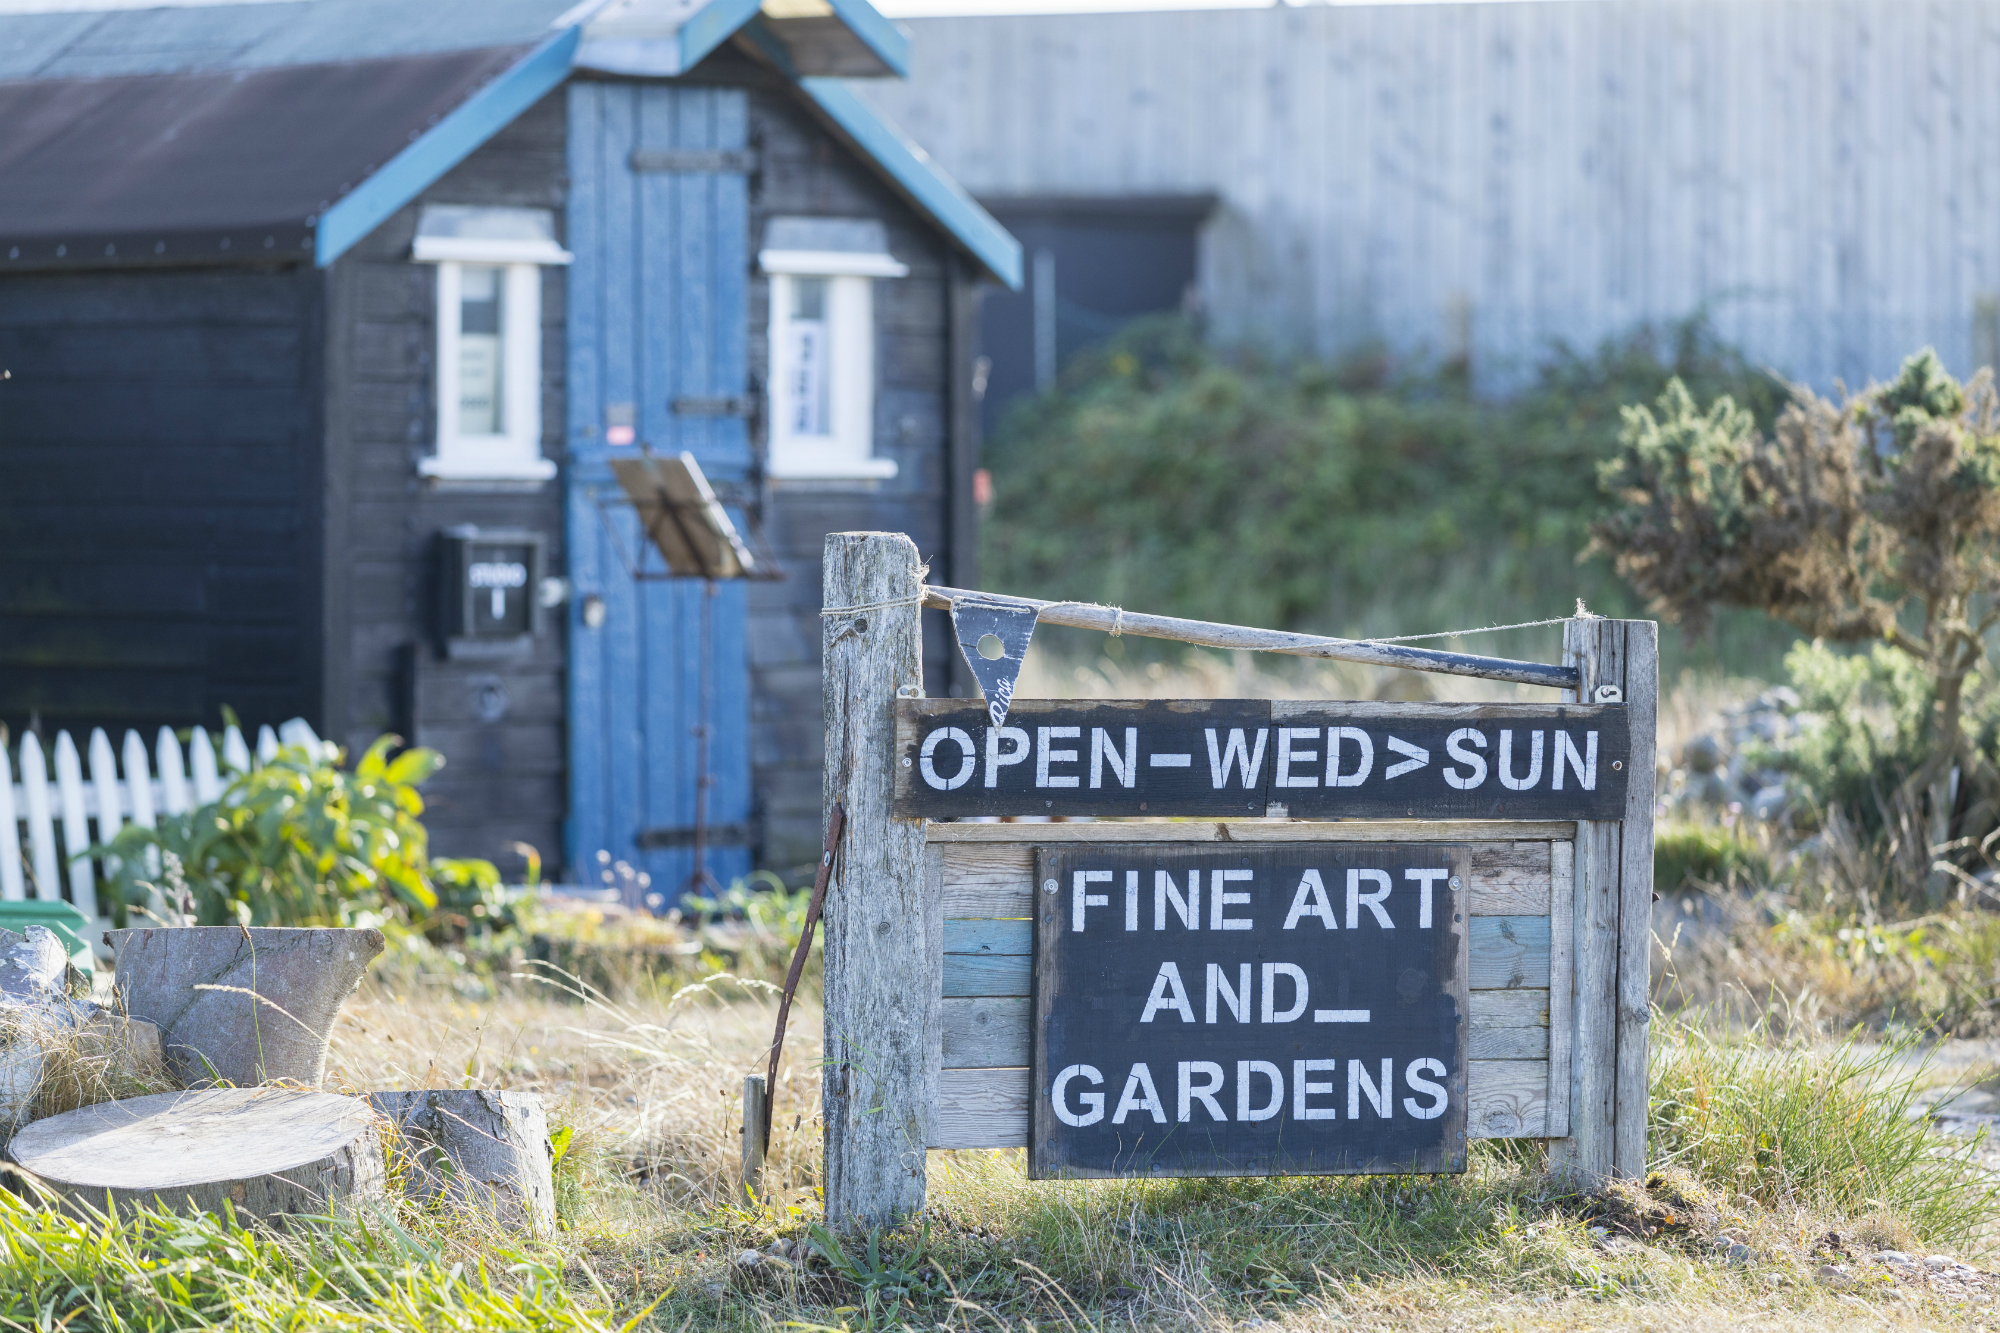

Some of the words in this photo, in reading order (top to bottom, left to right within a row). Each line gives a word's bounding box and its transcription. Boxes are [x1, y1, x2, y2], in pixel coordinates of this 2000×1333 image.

[1072, 869, 1254, 933] FINE
[1282, 867, 1450, 931] ART
[1051, 1057, 1449, 1128] GARDENS
